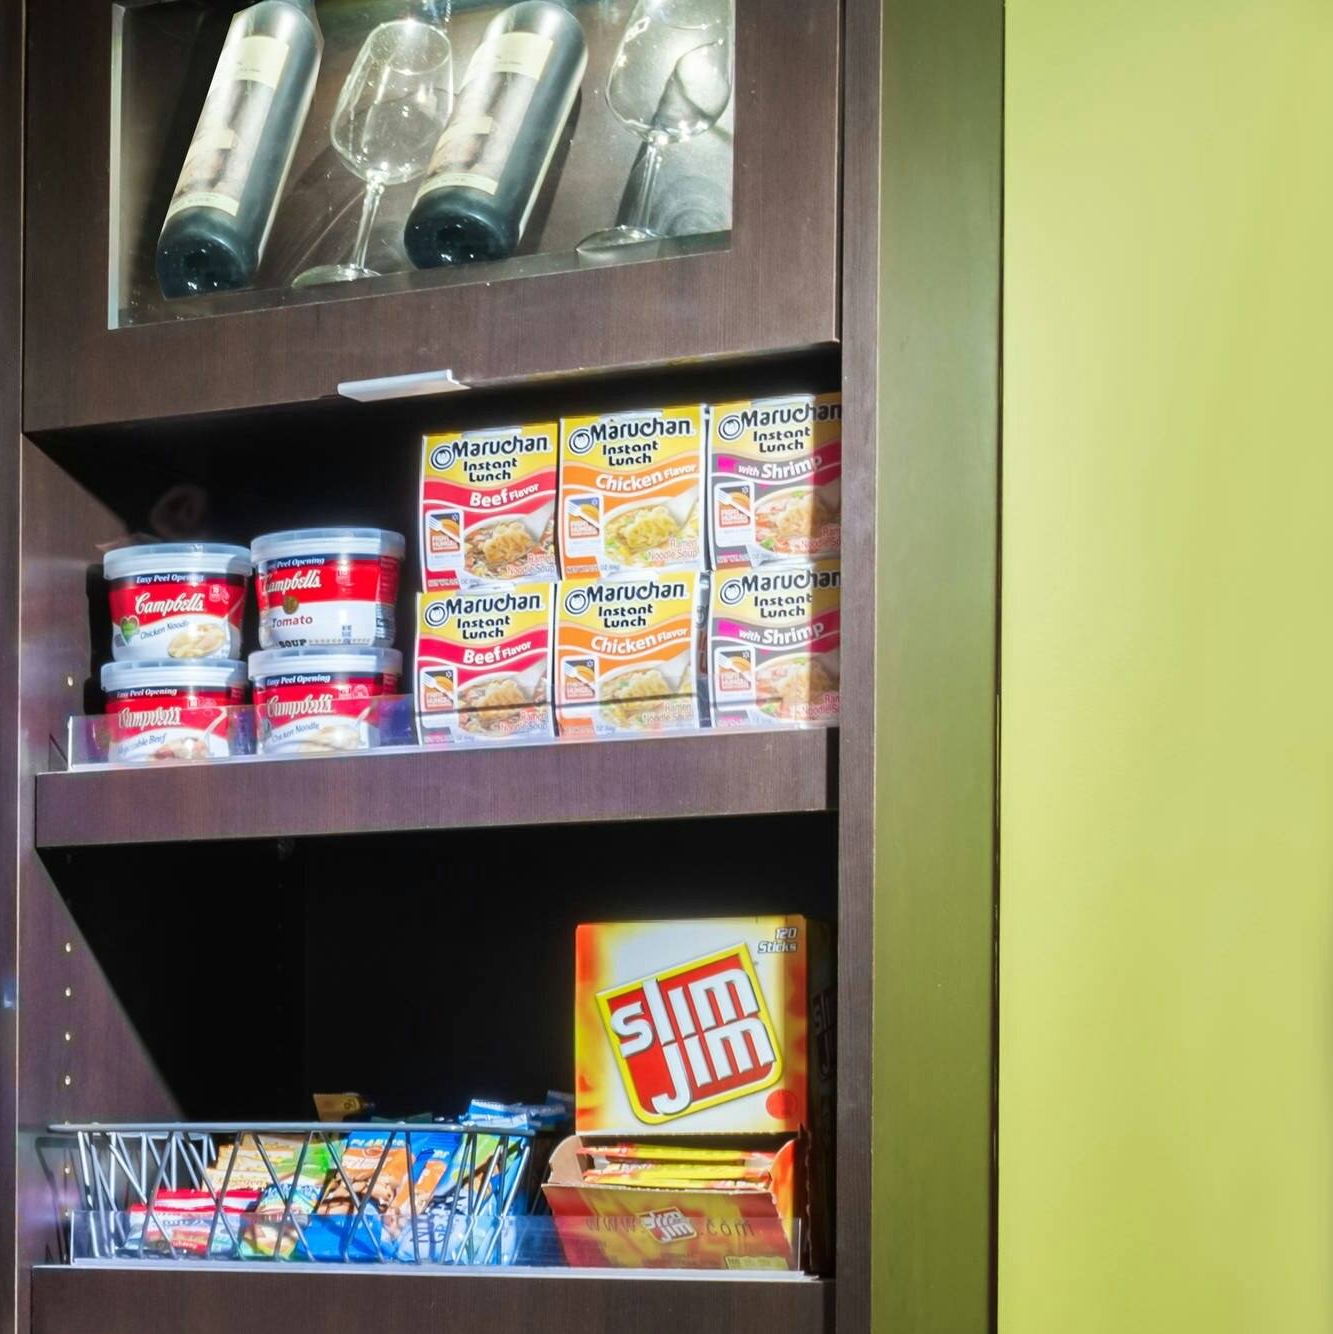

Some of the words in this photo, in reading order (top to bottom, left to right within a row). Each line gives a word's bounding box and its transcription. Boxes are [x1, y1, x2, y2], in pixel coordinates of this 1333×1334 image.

[740, 403, 841, 428] Maruchan
[589, 416, 692, 443] Maruchan
[753, 426, 811, 442] Instant
[451, 433, 549, 459] Maruchan
[601, 440, 659, 457] Instant
[759, 439, 805, 453] Lunch
[462, 456, 518, 473] Instant
[607, 452, 652, 468] Lunch
[738, 463, 760, 478] with
[760, 455, 823, 479] Shrimp
[467, 468, 512, 485] Lunch
[594, 469, 663, 493] Chicken
[664, 461, 697, 480] Flavor
[469, 488, 508, 509] Beef
[508, 481, 540, 502] Flavor
[276, 559, 291, 568] Peel
[291, 556, 326, 567] Opening
[676, 545, 699, 562] Soup
[136, 575, 152, 585] Easy
[152, 574, 170, 584] Peel
[170, 573, 204, 584] Opening
[262, 568, 322, 596] Campbell's
[740, 570, 841, 594] Maruchan
[585, 582, 686, 608] Maruchan
[753, 592, 814, 608] Instant
[134, 591, 205, 618] Campbell's
[445, 594, 542, 619] Maruchan
[597, 603, 654, 619] Instant
[759, 604, 806, 619] Lunch
[272, 613, 313, 629] Tomato
[456, 616, 511, 631] Instant
[603, 615, 648, 629] Lunch
[139, 626, 166, 641] Chicken
[166, 619, 190, 634] Noodle
[461, 626, 505, 641] Lunch
[738, 628, 761, 643] with
[761, 621, 825, 647] Shrimp
[278, 637, 308, 649] SOUP
[590, 632, 658, 655] Chicken
[658, 625, 689, 644] Flavor
[462, 646, 501, 666] Beef
[501, 640, 532, 660] Flavor
[130, 688, 143, 698] Peel
[143, 686, 178, 698] Opening
[266, 693, 335, 720] Campbell's
[118, 706, 182, 731] Campbell's
[296, 720, 320, 735] Noodle
[149, 733, 168, 747] Beef
[774, 927, 798, 942] 120
[757, 940, 798, 954] Sticks
